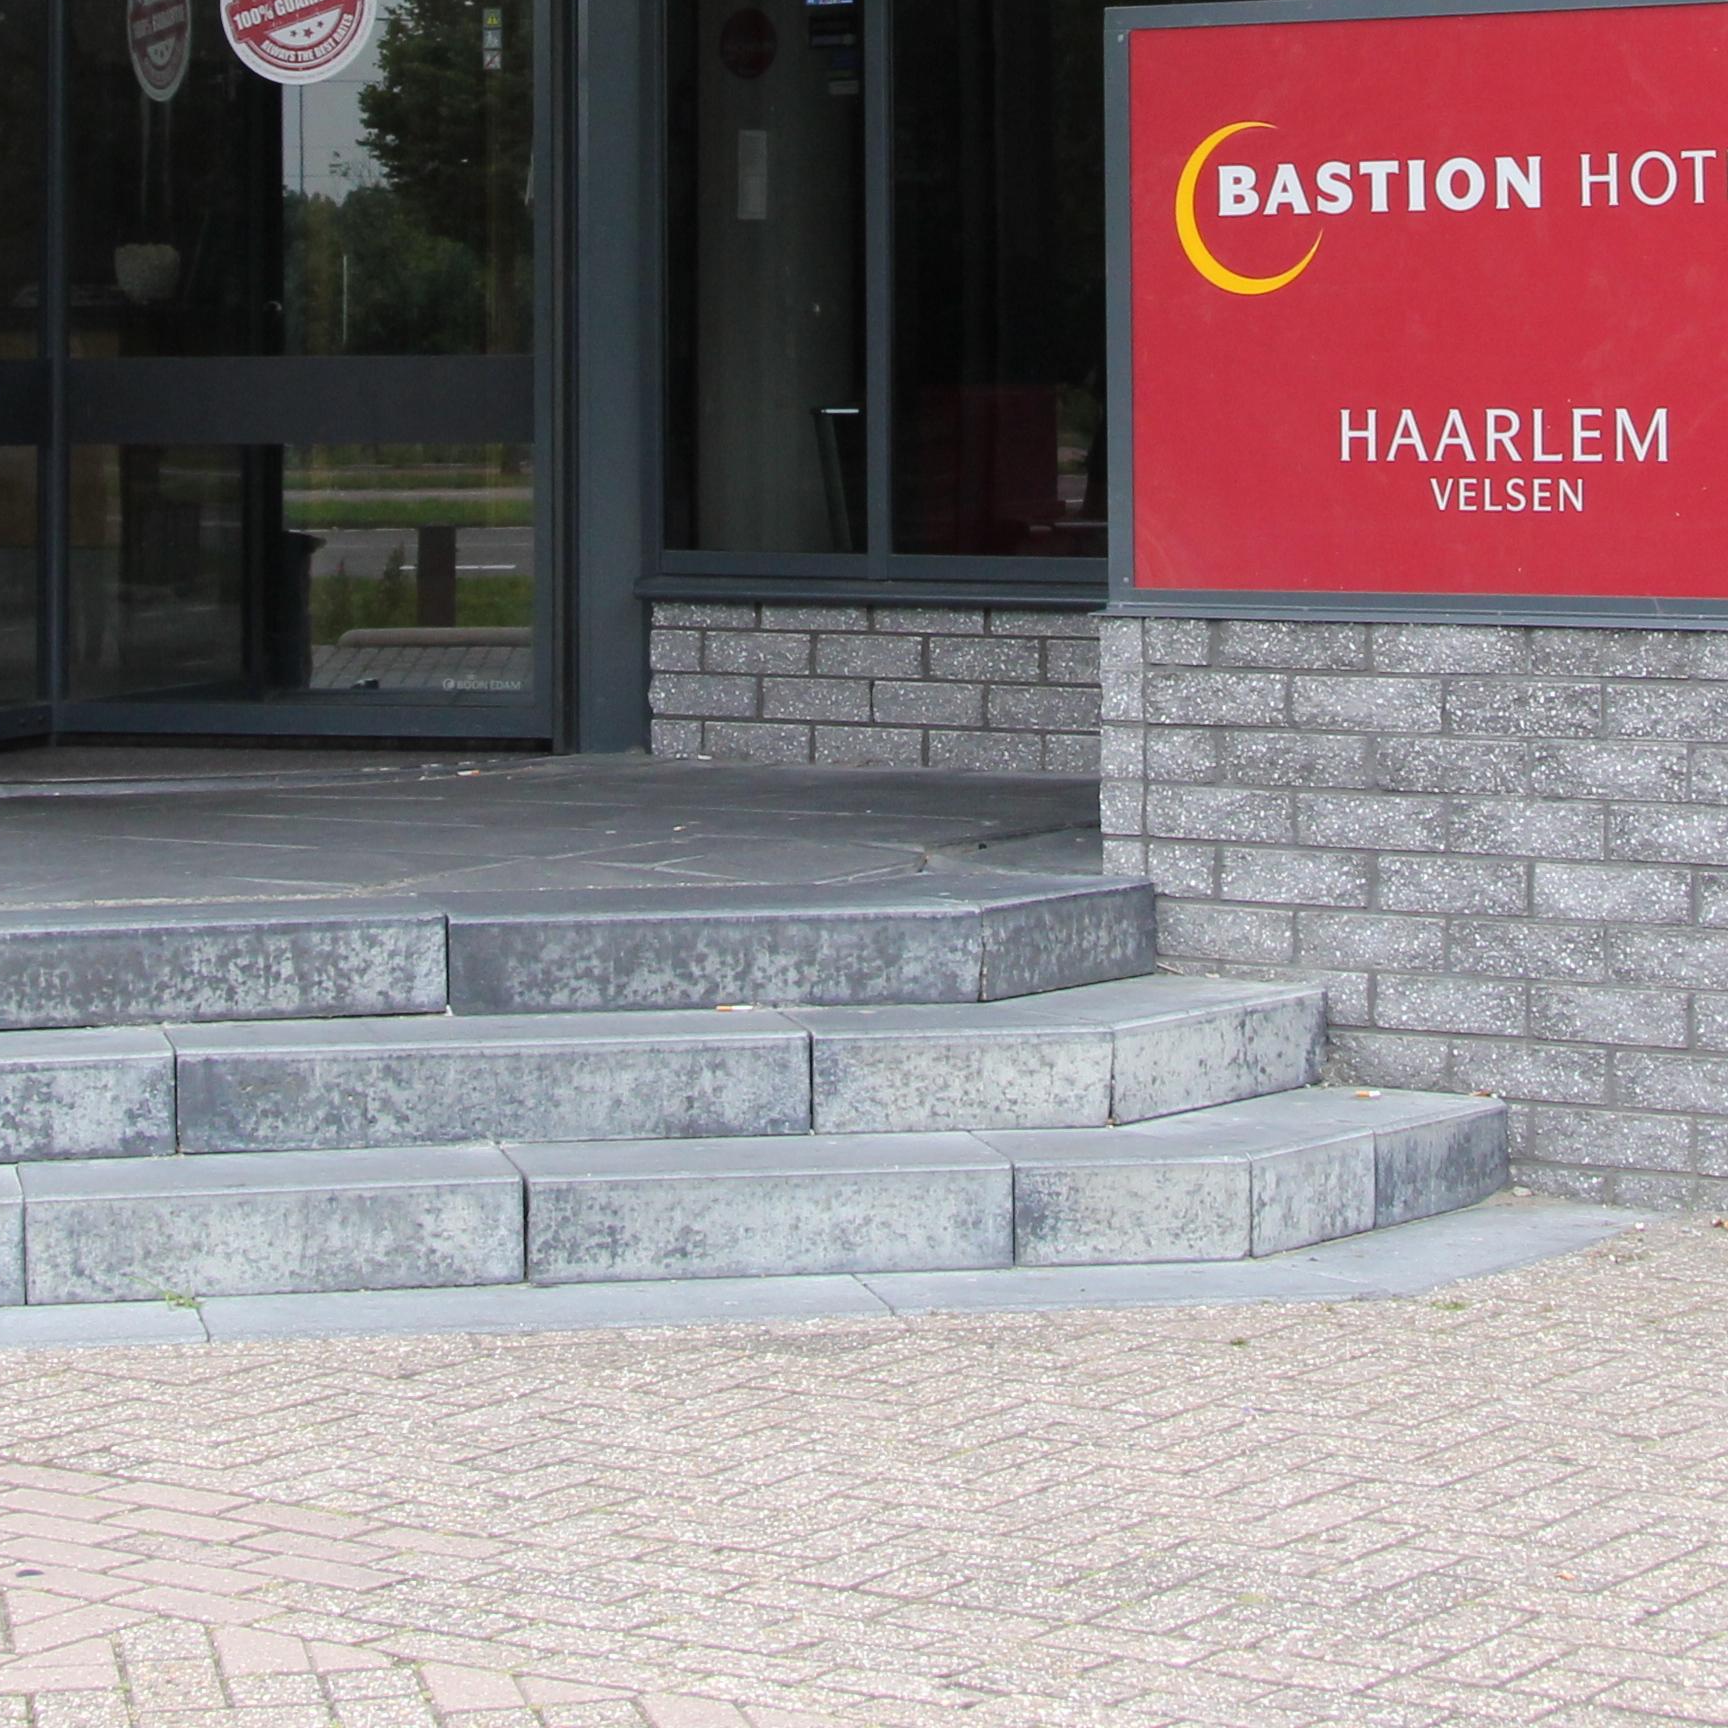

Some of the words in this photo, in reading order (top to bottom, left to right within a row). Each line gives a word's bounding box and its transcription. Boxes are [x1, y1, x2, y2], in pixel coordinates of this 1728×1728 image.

[233, 4, 274, 30] 100%
[260, 40, 296, 62] ALWAYS
[297, 51, 314, 62] THE
[314, 37, 337, 60] BEST
[1217, 155, 1542, 217] BASTION
[1339, 407, 1669, 463] HAARLEM
[1430, 477, 1584, 513] VELSEN
[489, 680, 521, 690] EDAM
